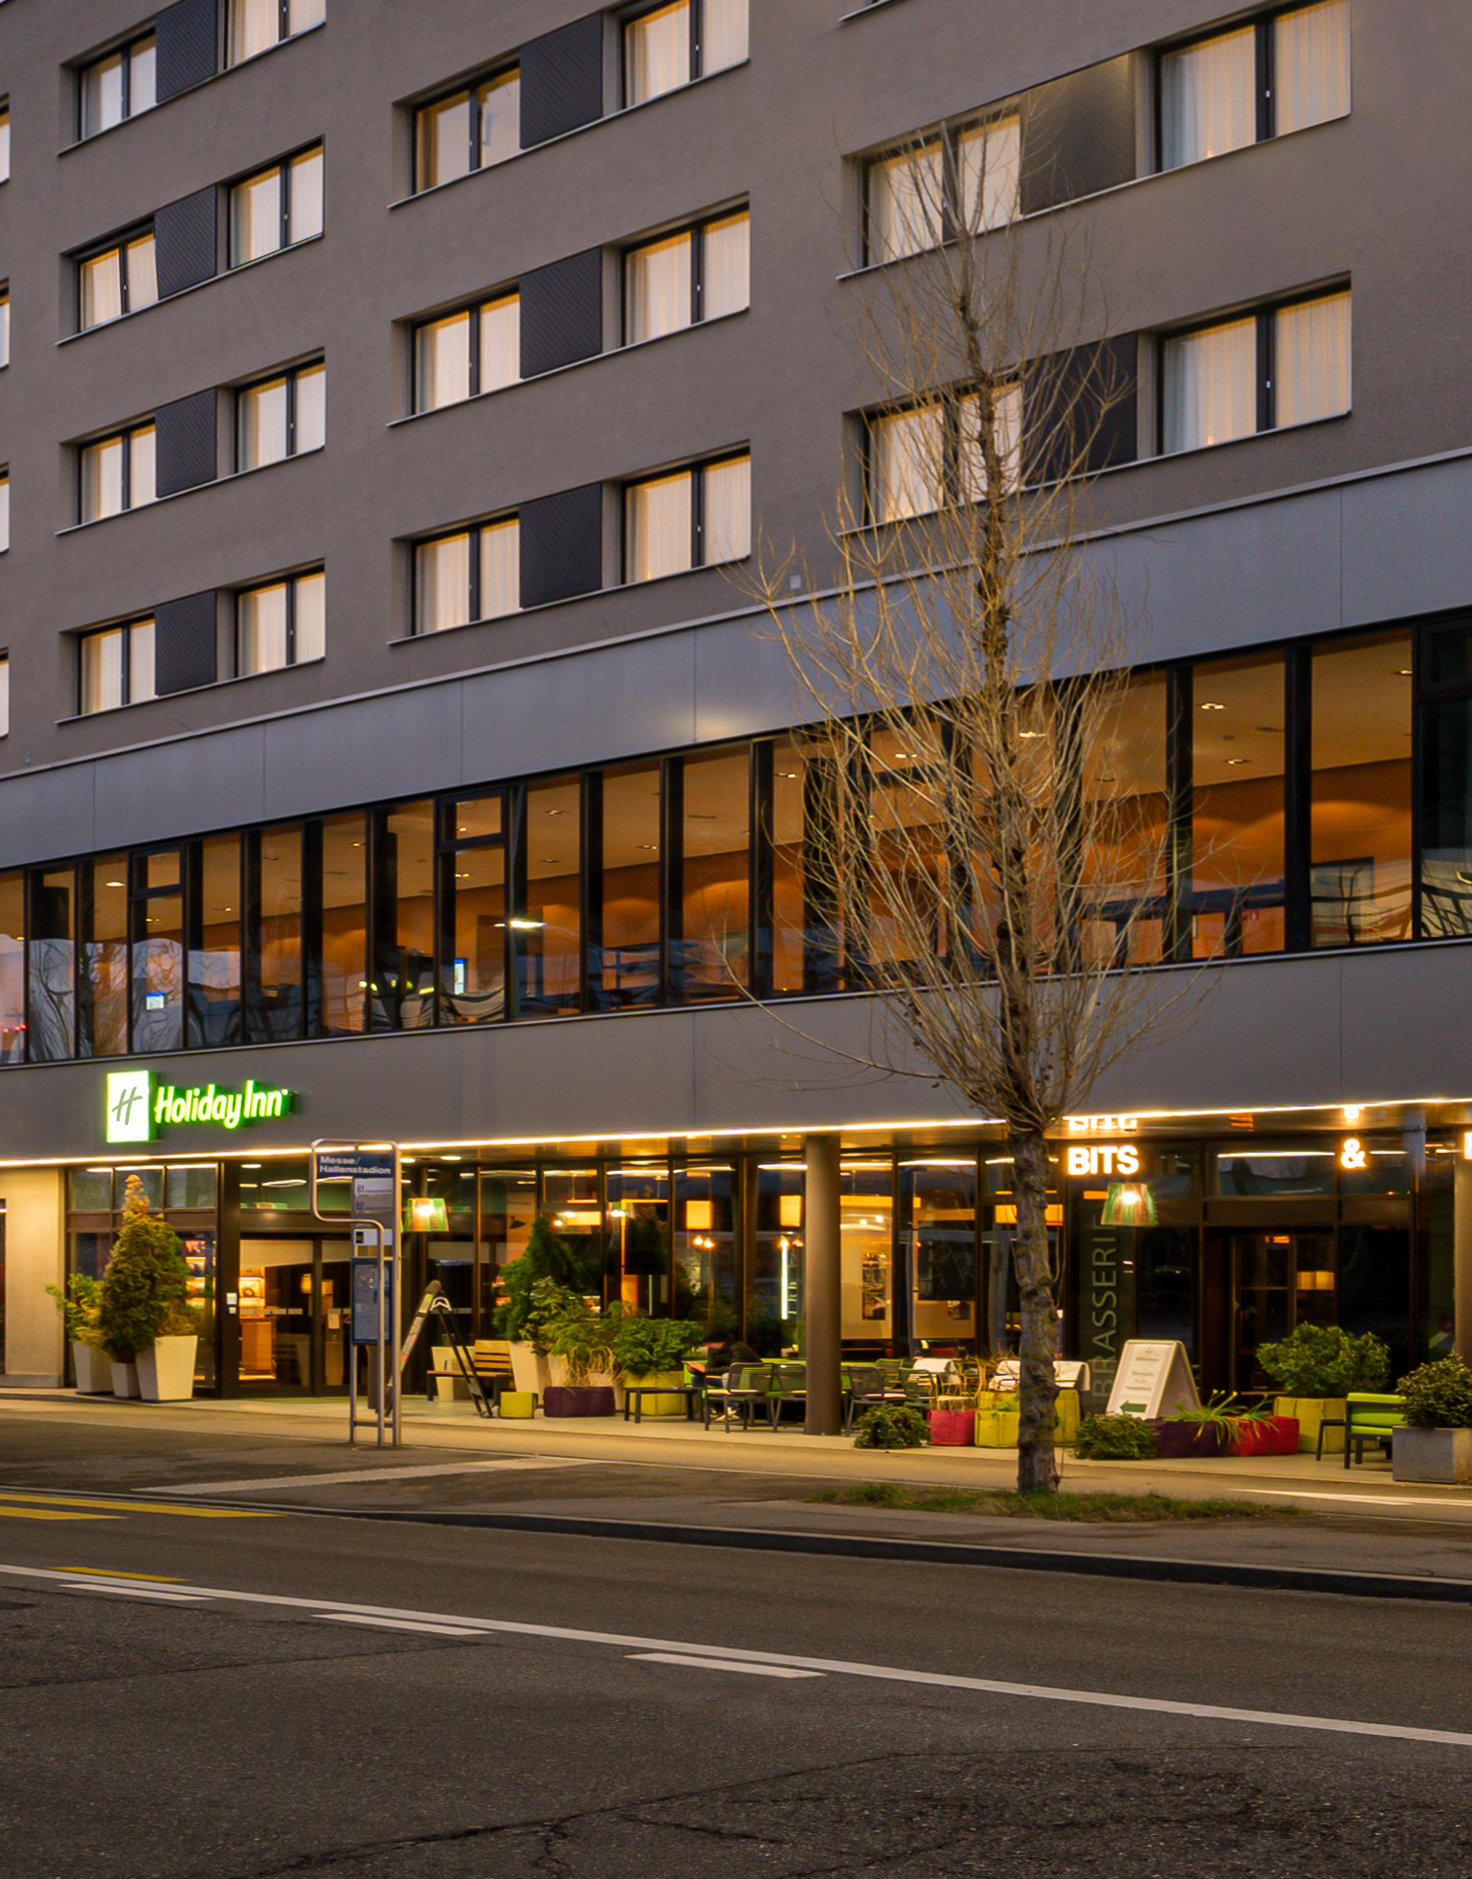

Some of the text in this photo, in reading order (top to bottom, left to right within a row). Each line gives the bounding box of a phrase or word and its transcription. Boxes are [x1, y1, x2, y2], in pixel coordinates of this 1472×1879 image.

[153, 1083, 243, 1130] Holiday
[242, 1079, 284, 1119] Inn
[319, 1155, 361, 1165] Messe/
[1066, 1144, 1140, 1176] BITS
[1340, 1137, 1367, 1169] &
[319, 1165, 392, 1175] Hallenstadion
